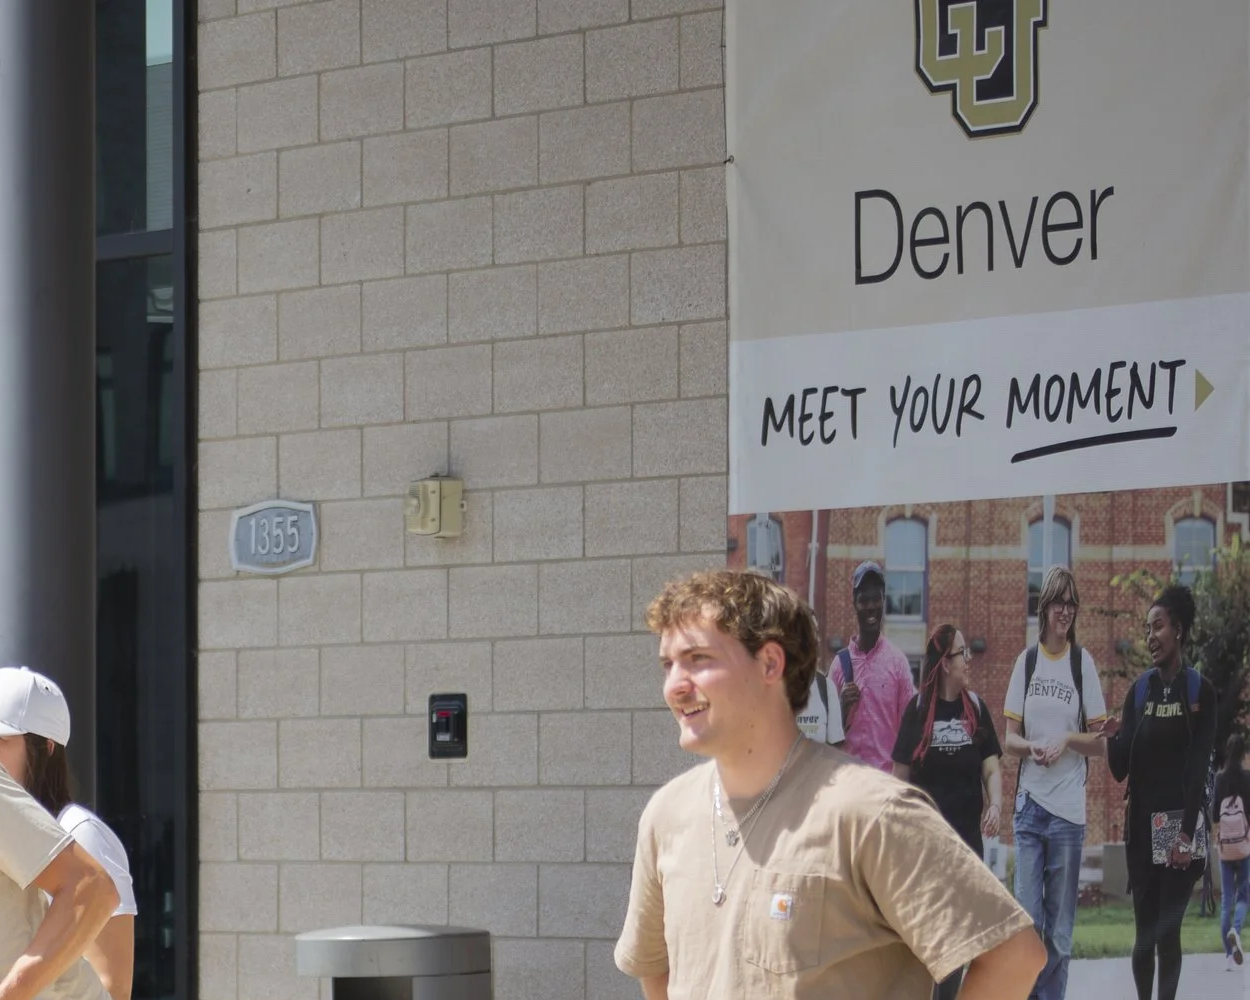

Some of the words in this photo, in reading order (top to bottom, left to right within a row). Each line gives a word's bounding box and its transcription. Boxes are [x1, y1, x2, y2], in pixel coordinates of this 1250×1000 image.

[854, 185, 1114, 285] Denver
[761, 386, 867, 446] MEET
[890, 373, 985, 448] YOUR
[1006, 359, 1187, 429] MOMENT
[249, 515, 300, 555] 1355
[1029, 682, 1072, 705] DENVER
